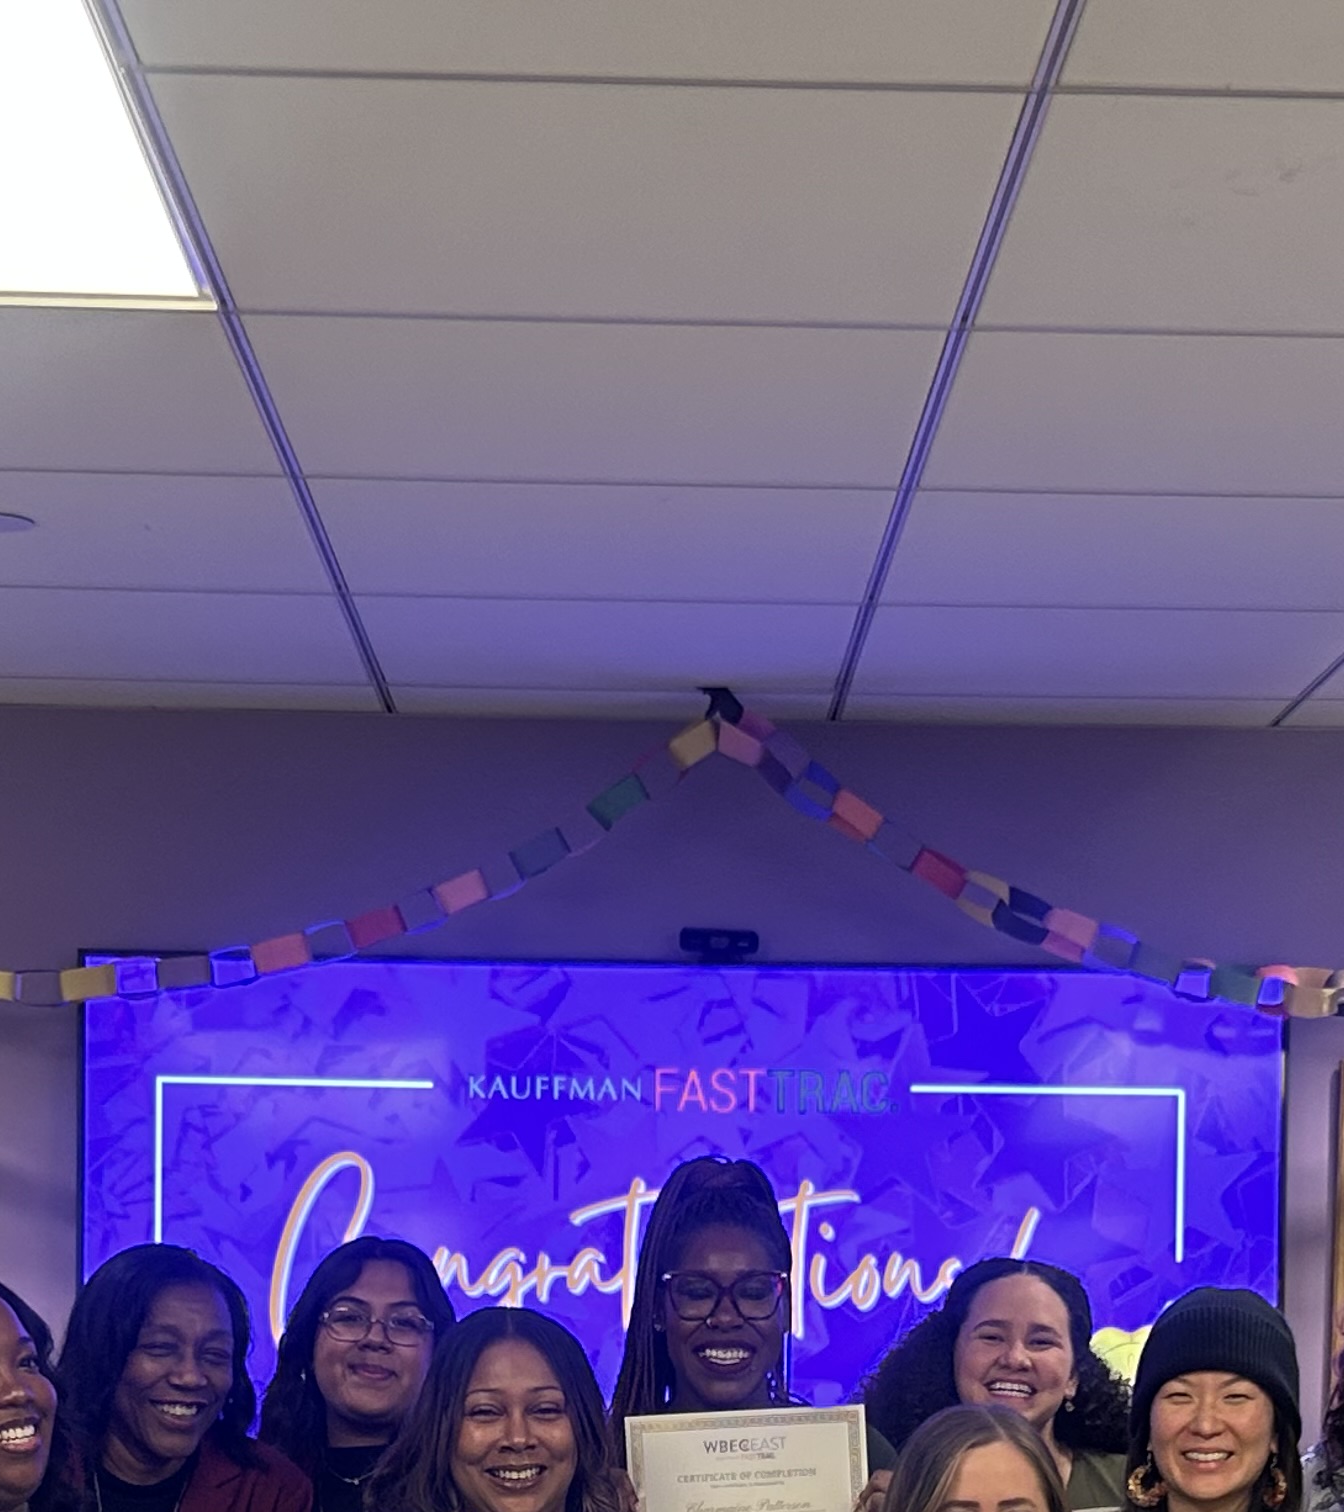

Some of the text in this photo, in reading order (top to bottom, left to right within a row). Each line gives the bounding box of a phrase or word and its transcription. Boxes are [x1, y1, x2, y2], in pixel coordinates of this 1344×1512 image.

[468, 1074, 642, 1101] KAUFFMAN
[677, 1468, 816, 1483] CERTIFICATE OF COMPLETION
